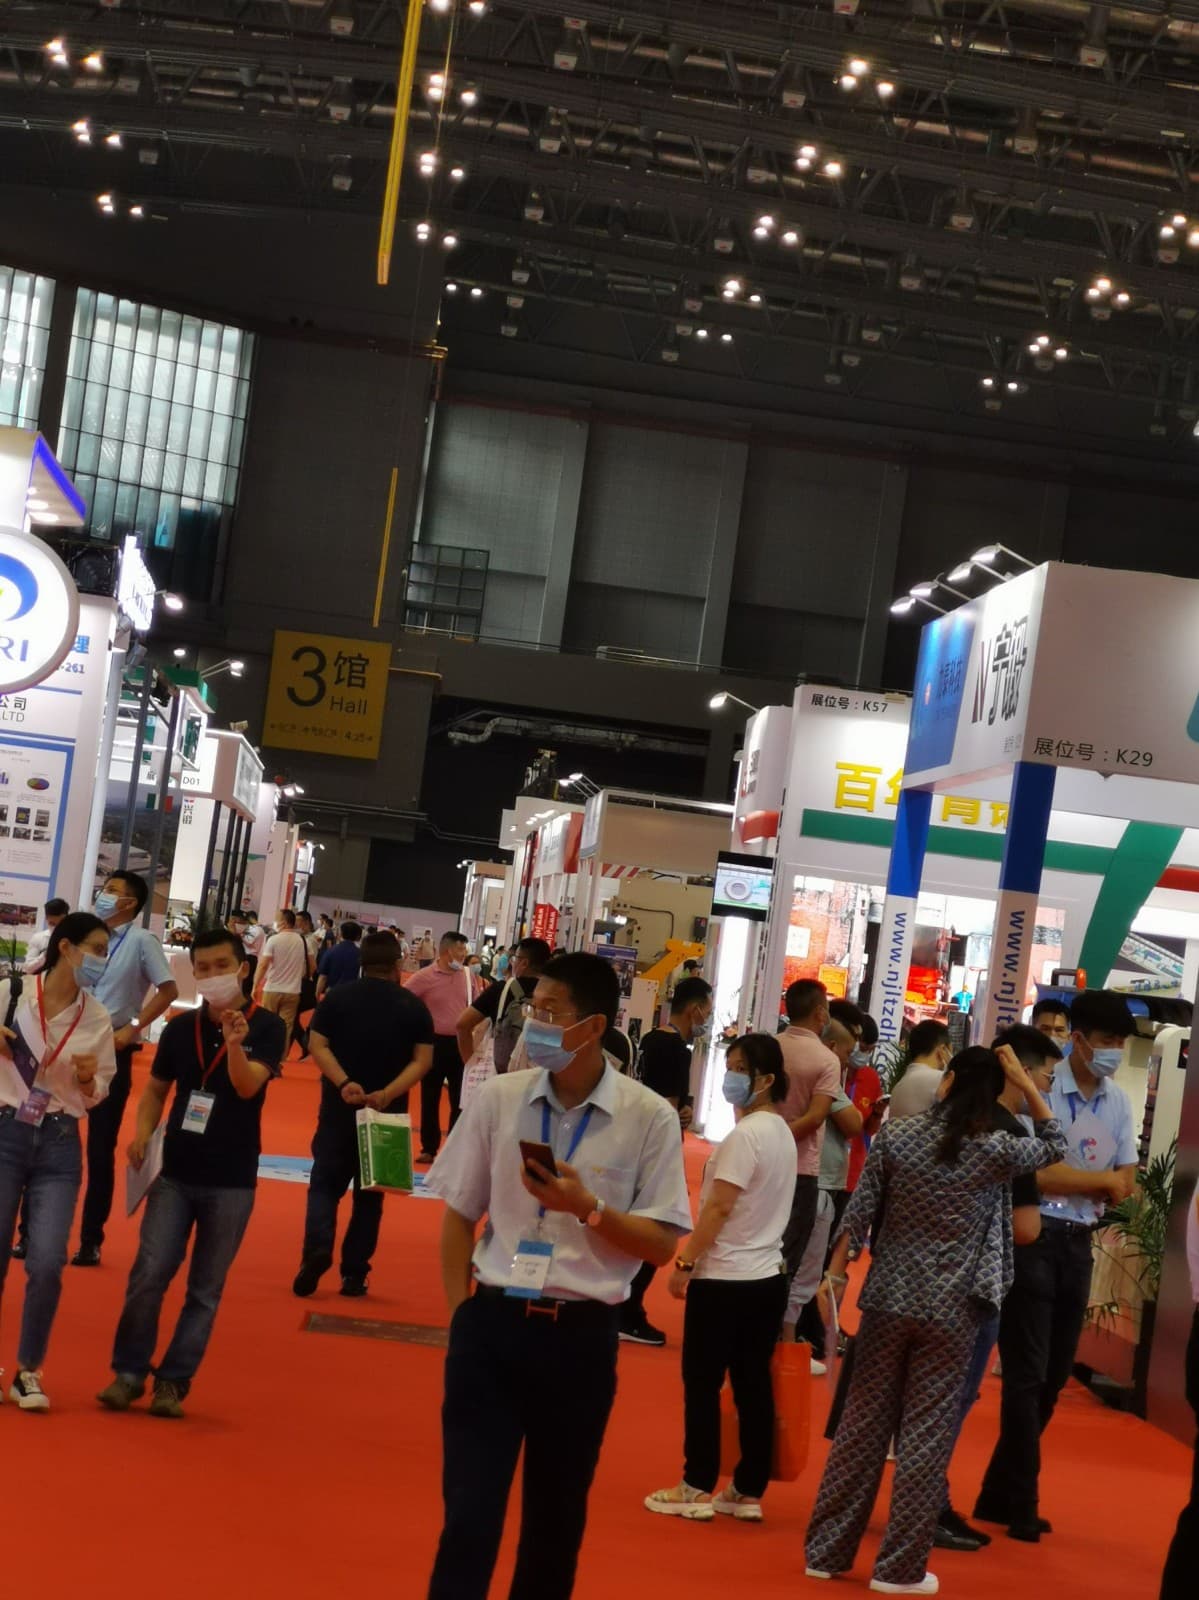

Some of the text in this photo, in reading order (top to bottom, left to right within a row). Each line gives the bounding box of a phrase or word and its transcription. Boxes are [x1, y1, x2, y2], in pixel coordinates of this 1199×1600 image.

[287, 646, 327, 708] 3
[334, 650, 369, 688] 馆
[329, 695, 368, 714] Hall
